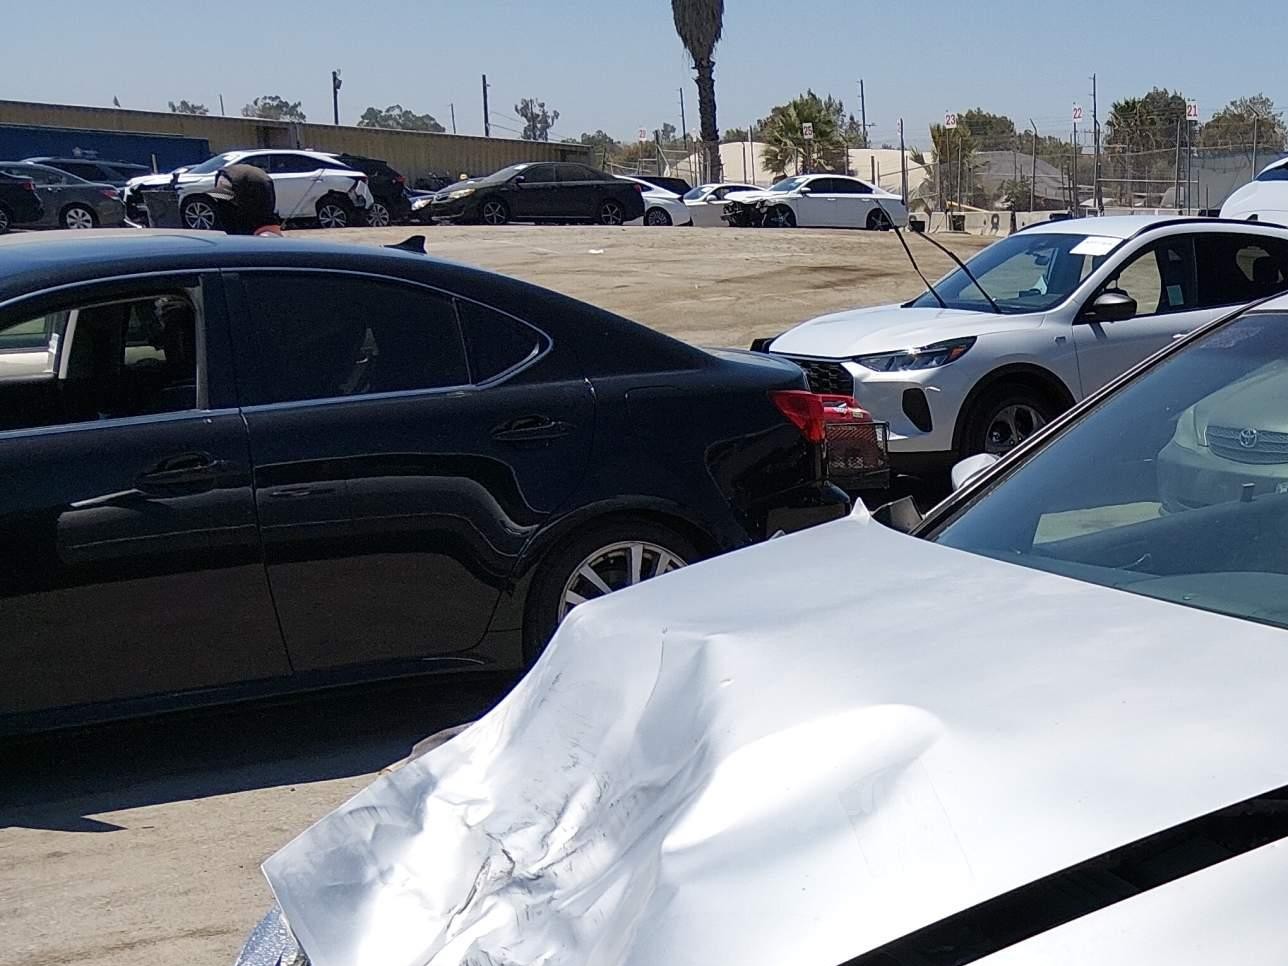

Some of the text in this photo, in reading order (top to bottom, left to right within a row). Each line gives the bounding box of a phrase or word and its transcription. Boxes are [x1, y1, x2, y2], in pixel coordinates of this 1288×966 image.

[1073, 106, 1083, 119] 22
[1186, 103, 1198, 117] 21
[945, 113, 956, 126] 23
[802, 125, 814, 137] 25
